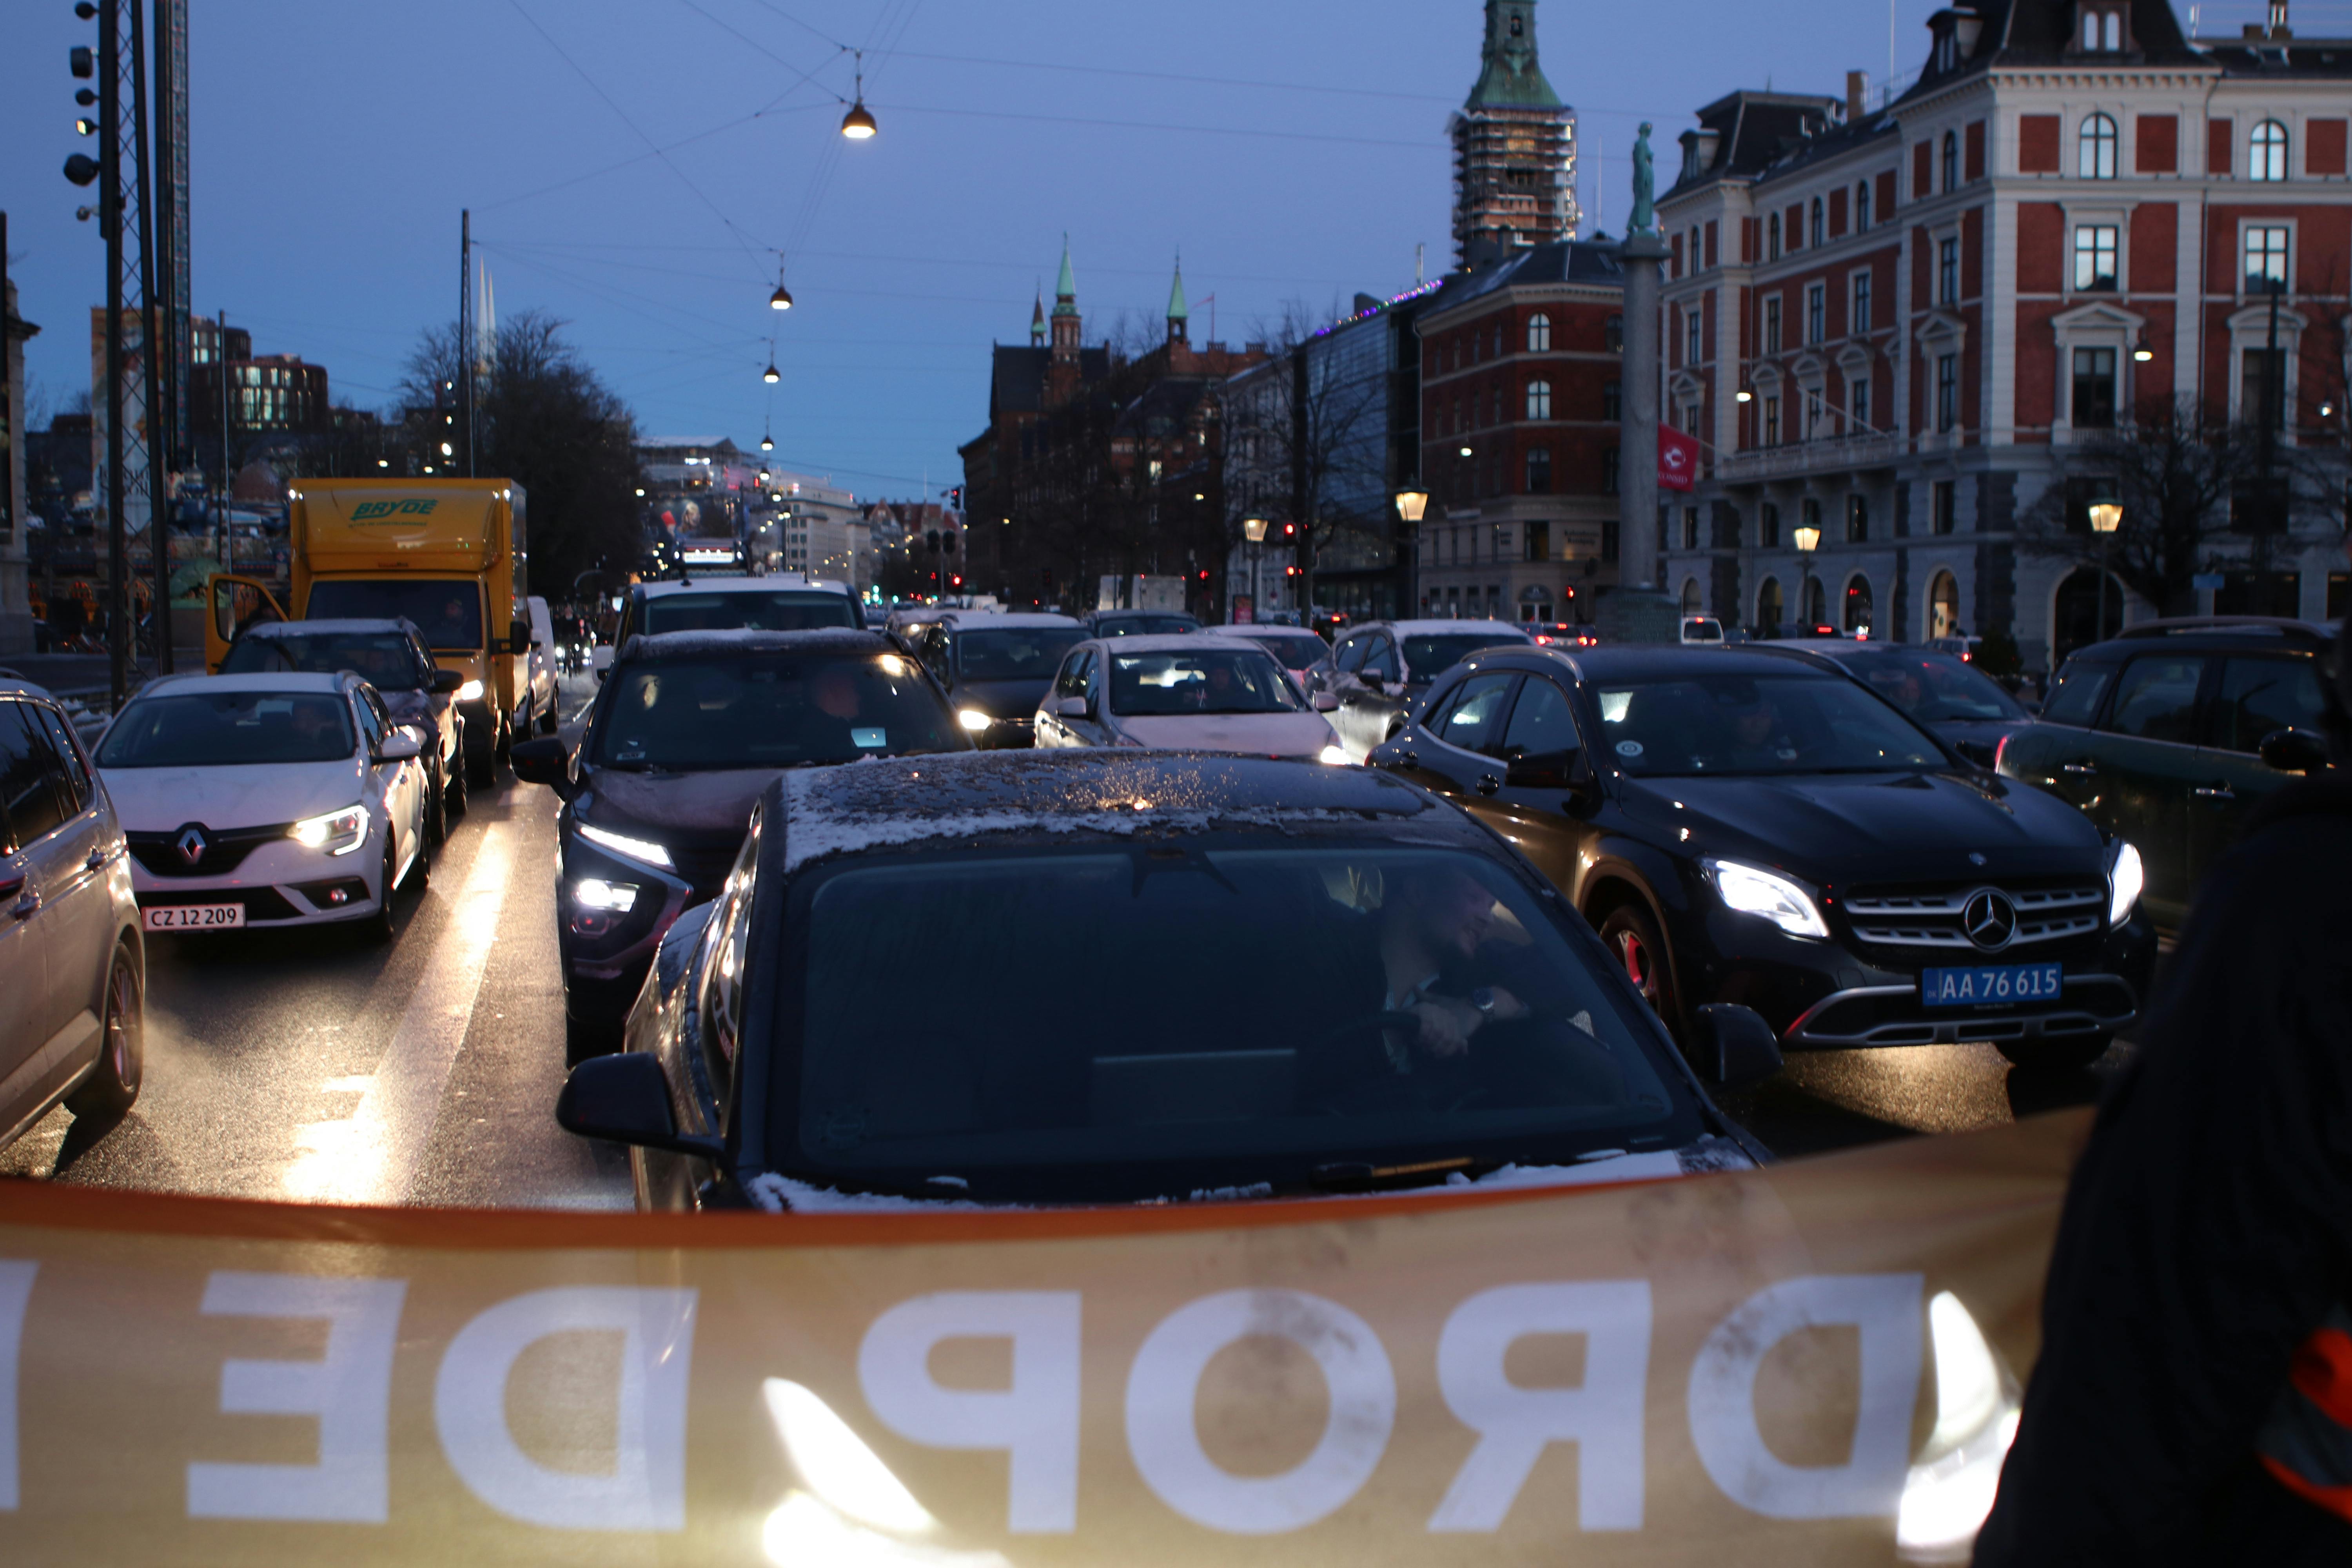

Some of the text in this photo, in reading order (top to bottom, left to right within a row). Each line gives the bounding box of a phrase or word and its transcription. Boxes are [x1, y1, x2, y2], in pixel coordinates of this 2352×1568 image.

[351, 500, 438, 521] BRYDE
[151, 908, 237, 926] CZ 12 209
[1942, 969, 2058, 999] AA 76 615
